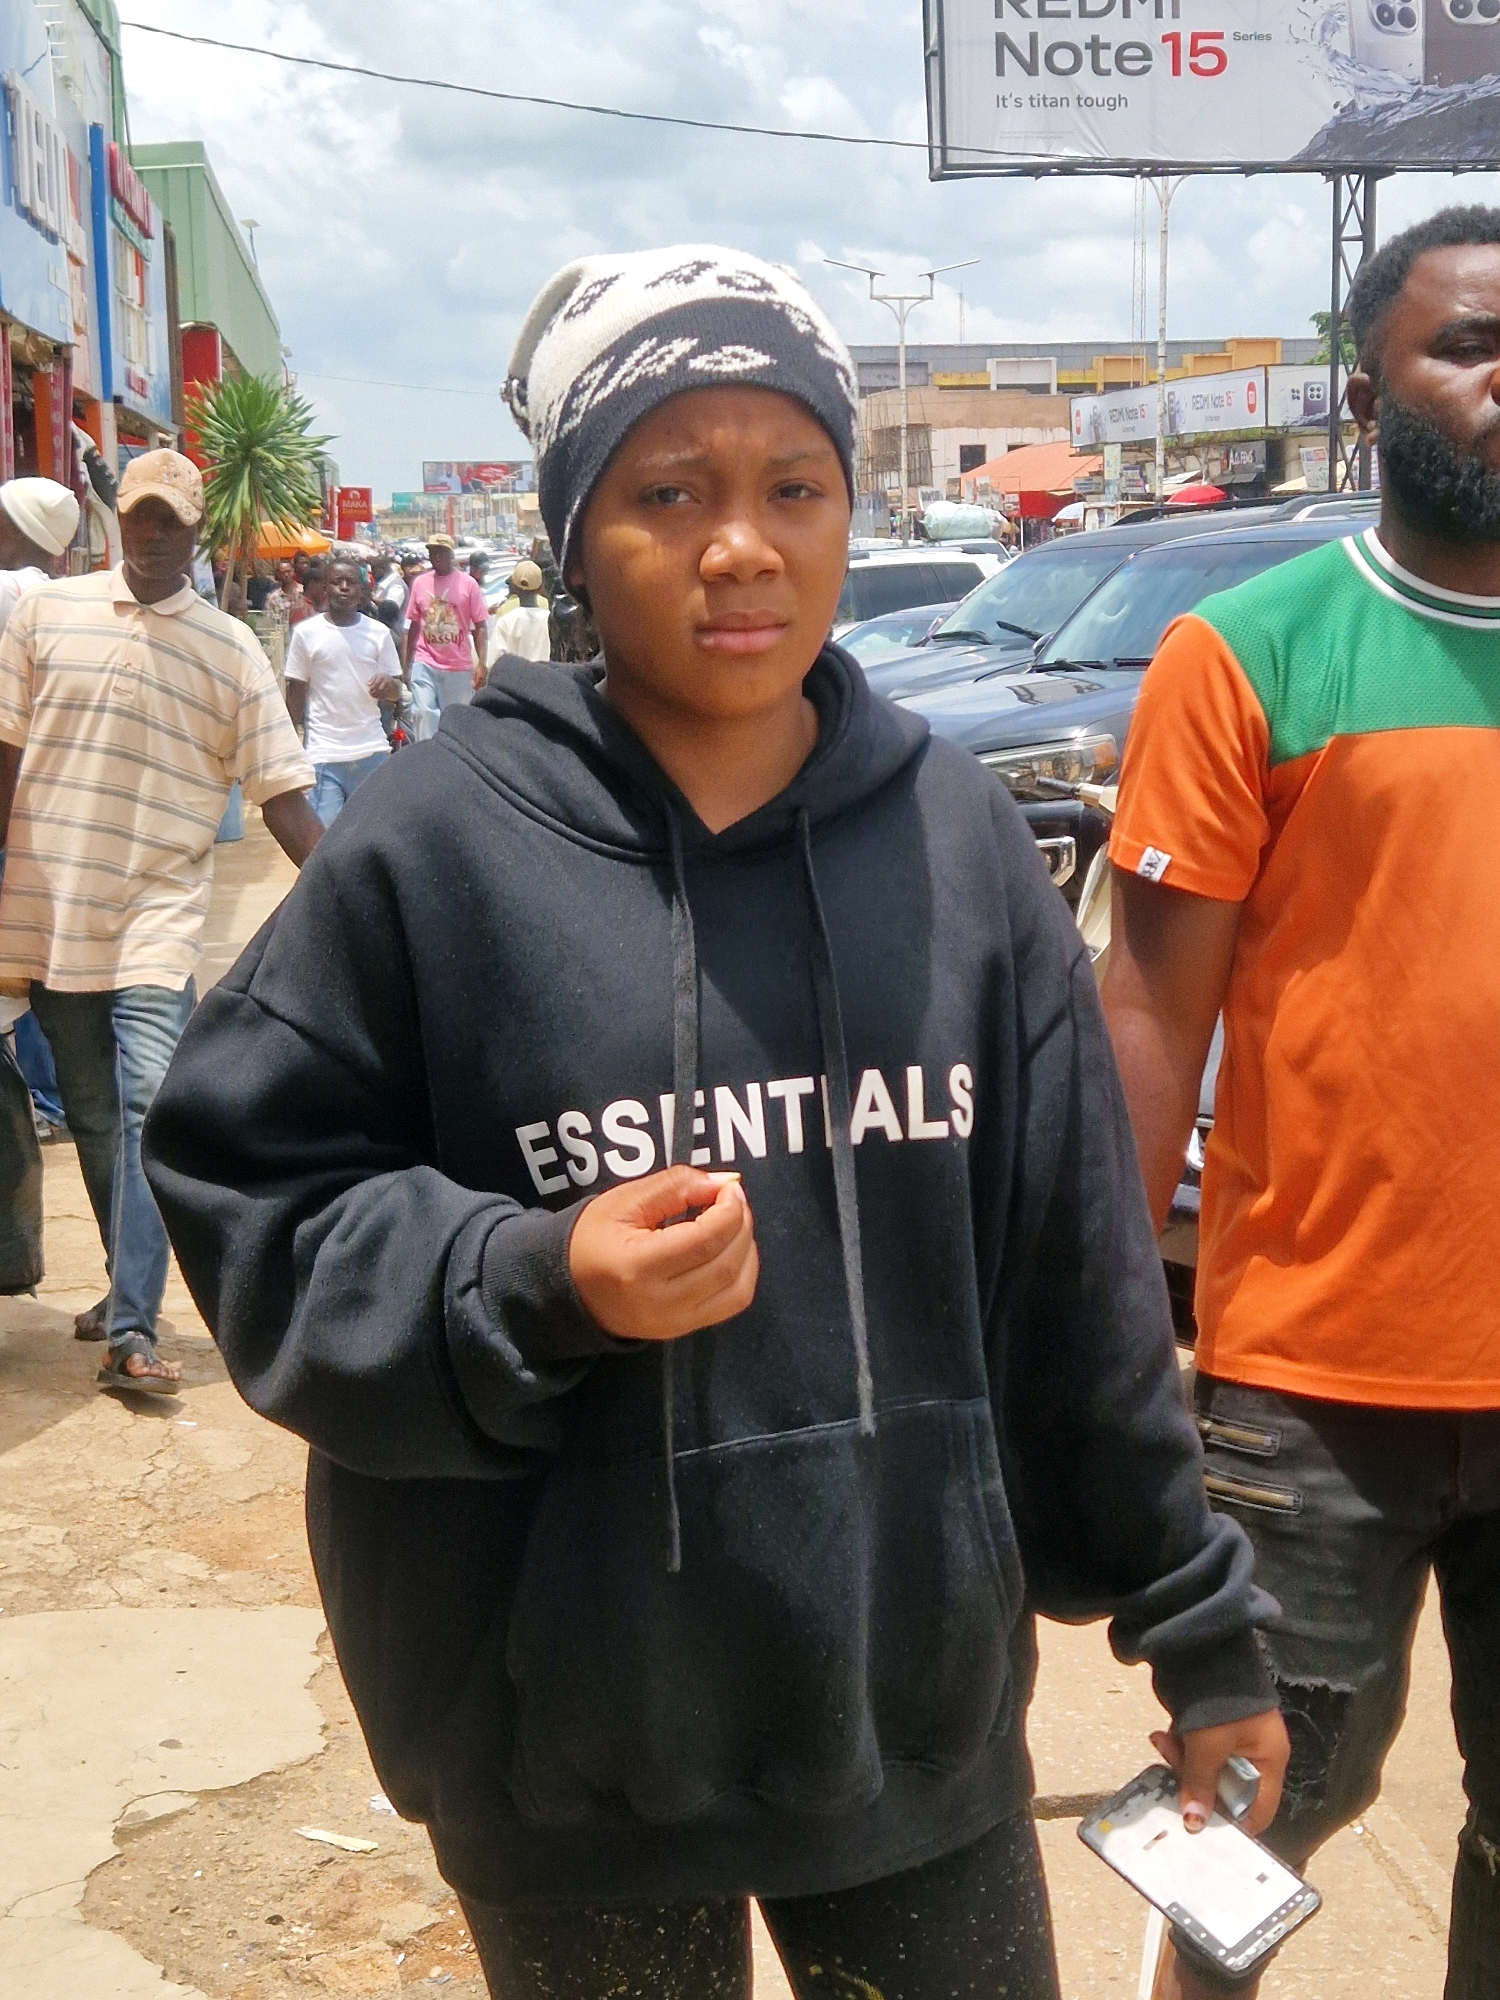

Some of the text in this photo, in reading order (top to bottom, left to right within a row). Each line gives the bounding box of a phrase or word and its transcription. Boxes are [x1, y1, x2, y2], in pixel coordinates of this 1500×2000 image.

[994, 30, 1273, 77] Note 15 Series
[996, 92, 1129, 112] It's titan tough
